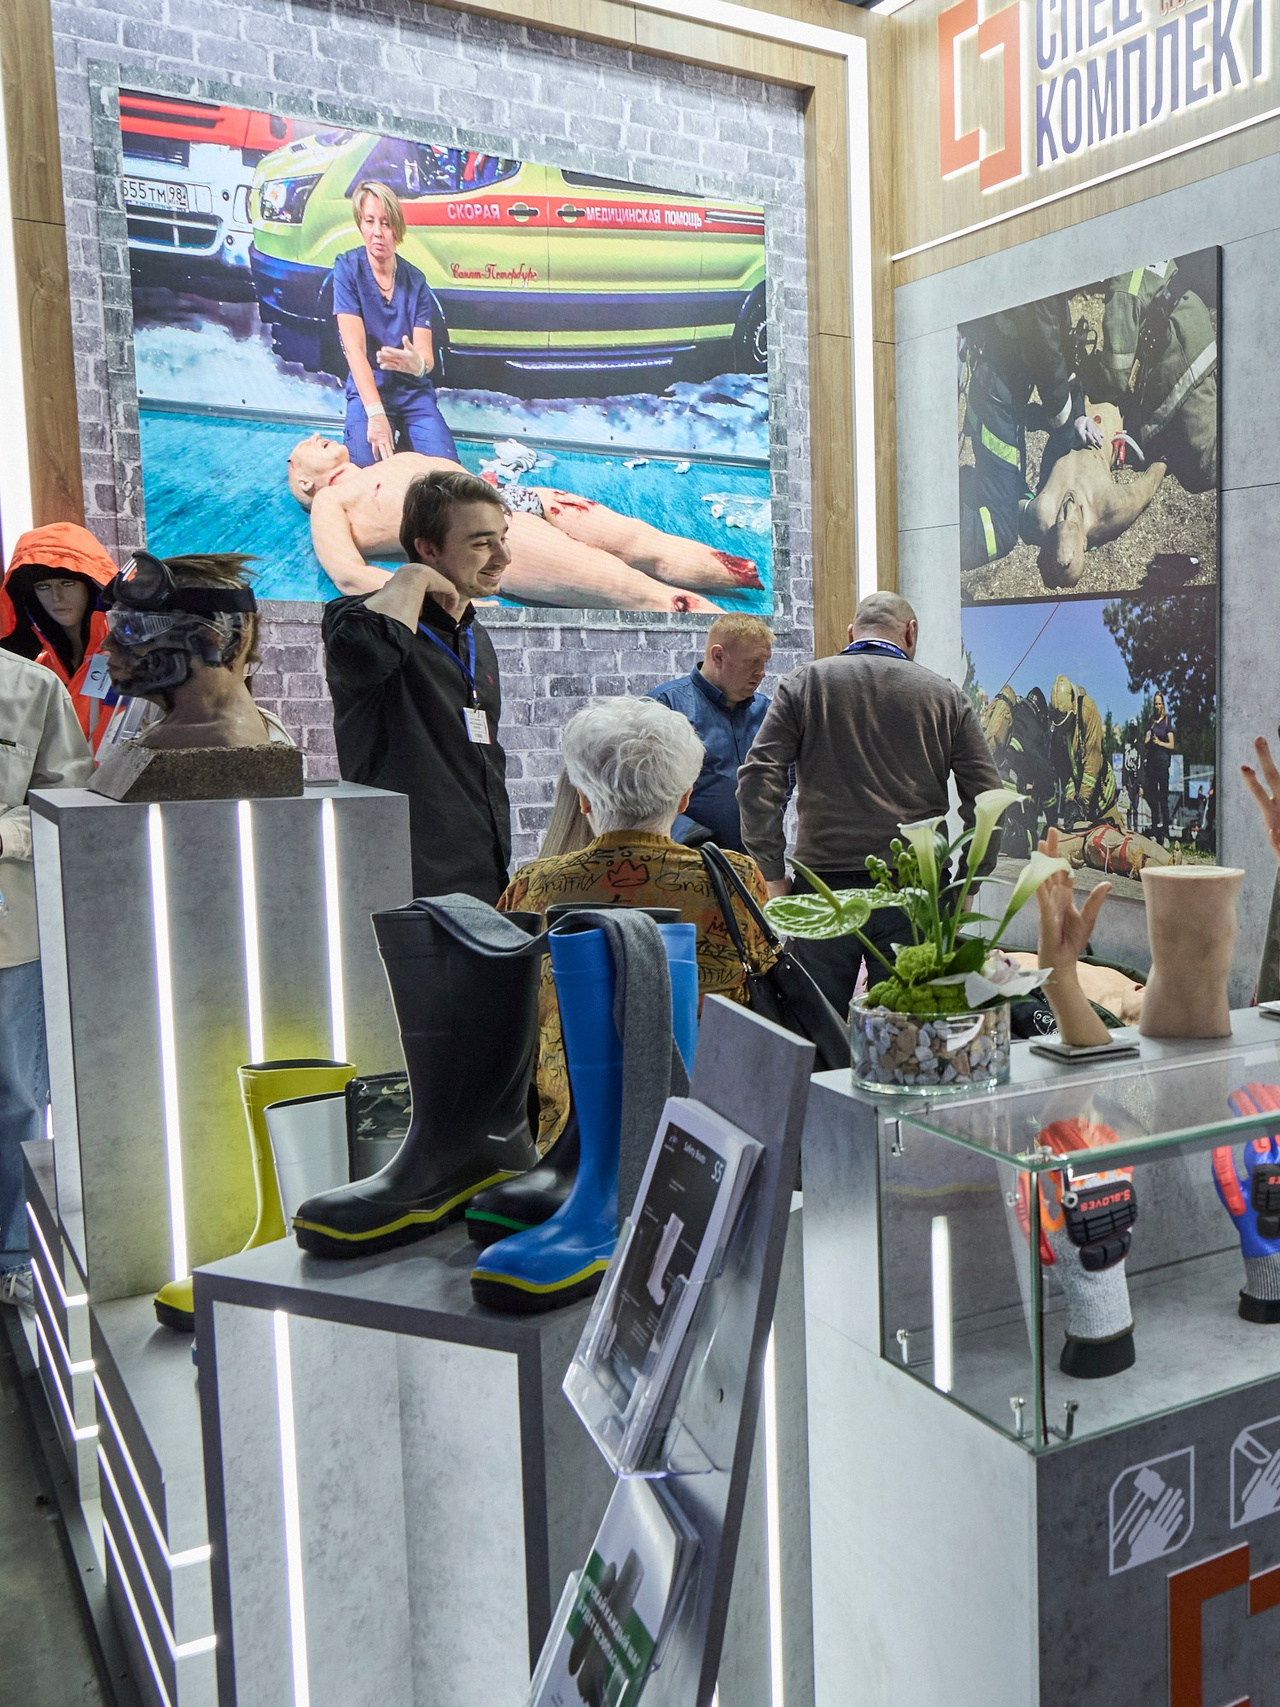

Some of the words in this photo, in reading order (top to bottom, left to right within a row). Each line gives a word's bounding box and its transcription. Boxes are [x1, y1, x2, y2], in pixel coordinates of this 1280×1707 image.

[1036, 0, 1263, 168] КОМПЛЕКТ
[447, 203, 500, 219] СКОРАЯ
[586, 206, 661, 225] МЕДИЦИНСКАЯ
[664, 209, 703, 229] ПОМОЩЬ
[711, 1160, 725, 1183] S5
[1080, 1189, 1131, 1212] S.GLOVES
